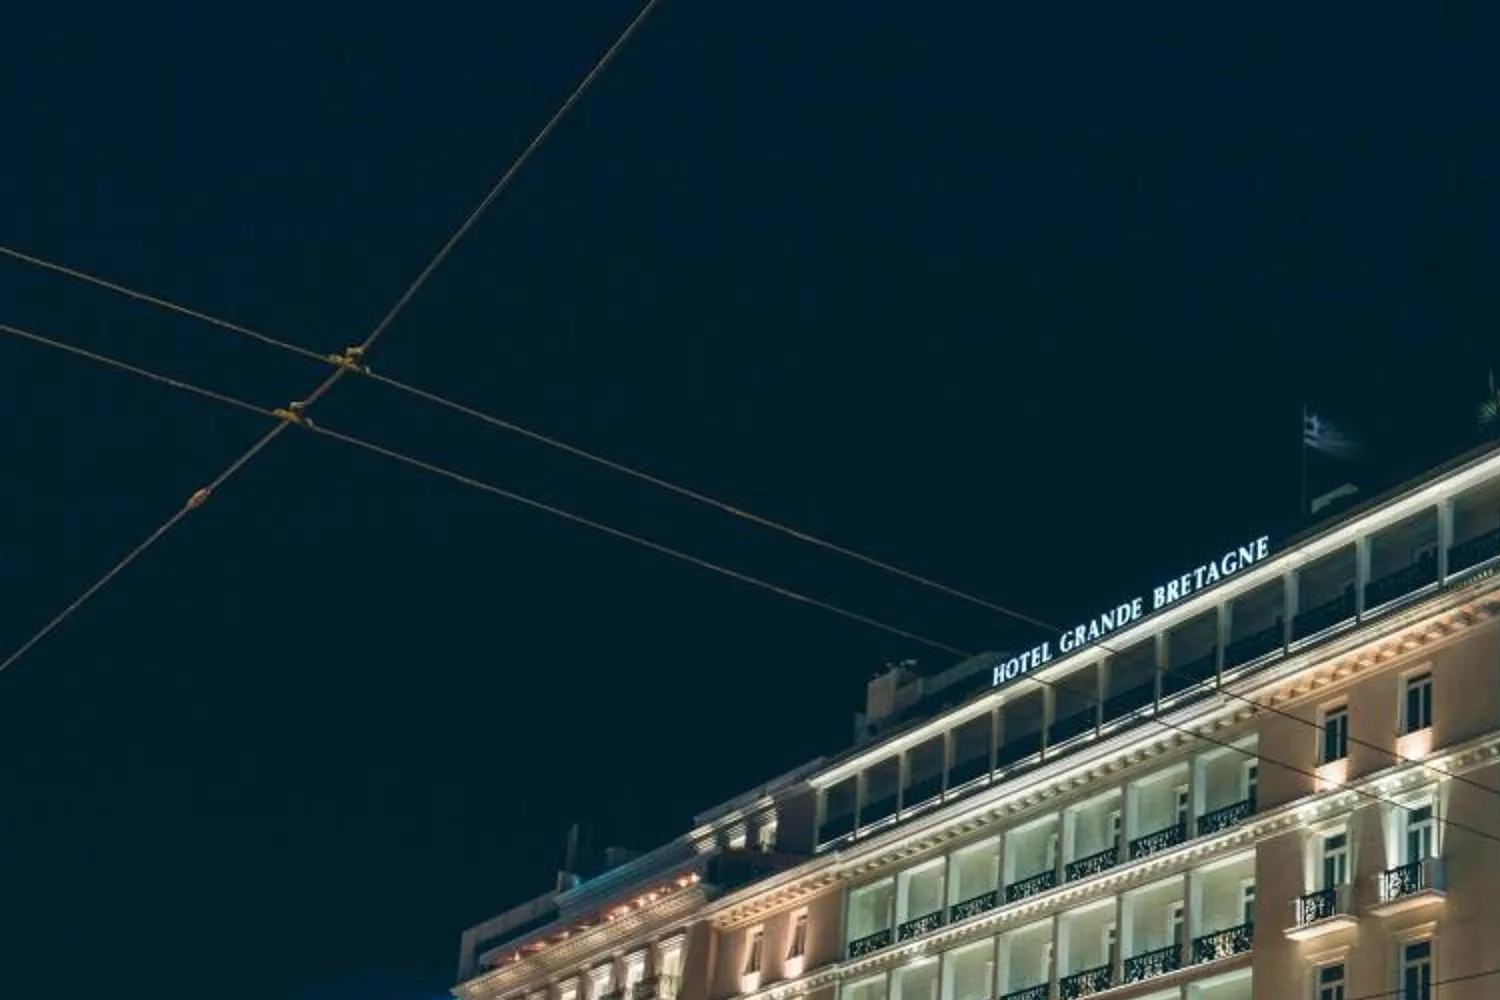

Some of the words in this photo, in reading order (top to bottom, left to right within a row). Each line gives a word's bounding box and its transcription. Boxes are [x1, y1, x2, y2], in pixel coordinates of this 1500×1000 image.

[992, 641, 1052, 687] HOTEL
[1059, 597, 1144, 653] GRANDE
[1153, 535, 1269, 609] BRETAGNE
